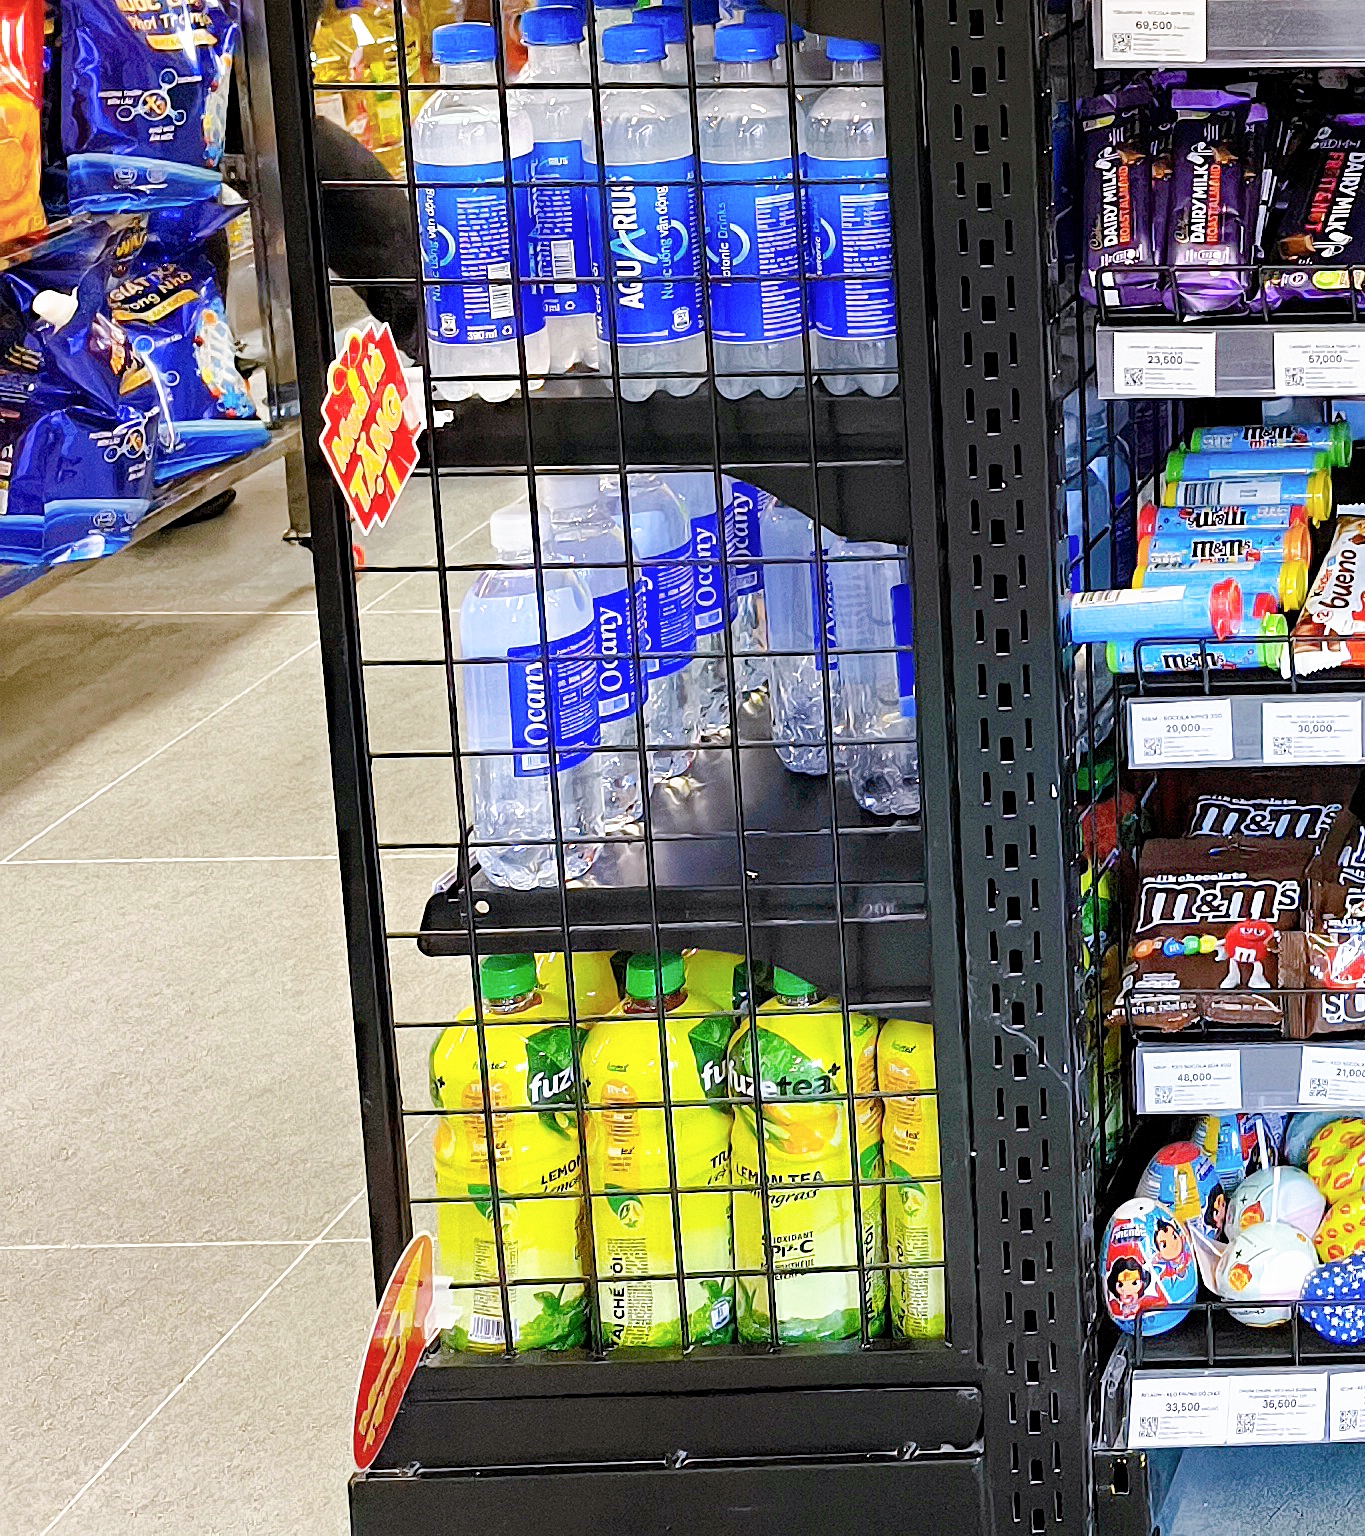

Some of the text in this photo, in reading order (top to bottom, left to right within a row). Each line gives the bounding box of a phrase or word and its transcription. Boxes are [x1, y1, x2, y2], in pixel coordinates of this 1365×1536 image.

[1103, 203, 1118, 247] DAIRY
[695, 527, 718, 609] Ocany
[1329, 545, 1358, 612] bueno
[599, 606, 624, 693] Ocany
[524, 661, 550, 748] Ocany
[1166, 723, 1201, 733] 20,000
[1192, 800, 1344, 837] m&m's
[1138, 877, 1299, 929] m&m's
[1177, 1072, 1213, 1083] 48,000
[1165, 1402, 1200, 1413] 33,500
